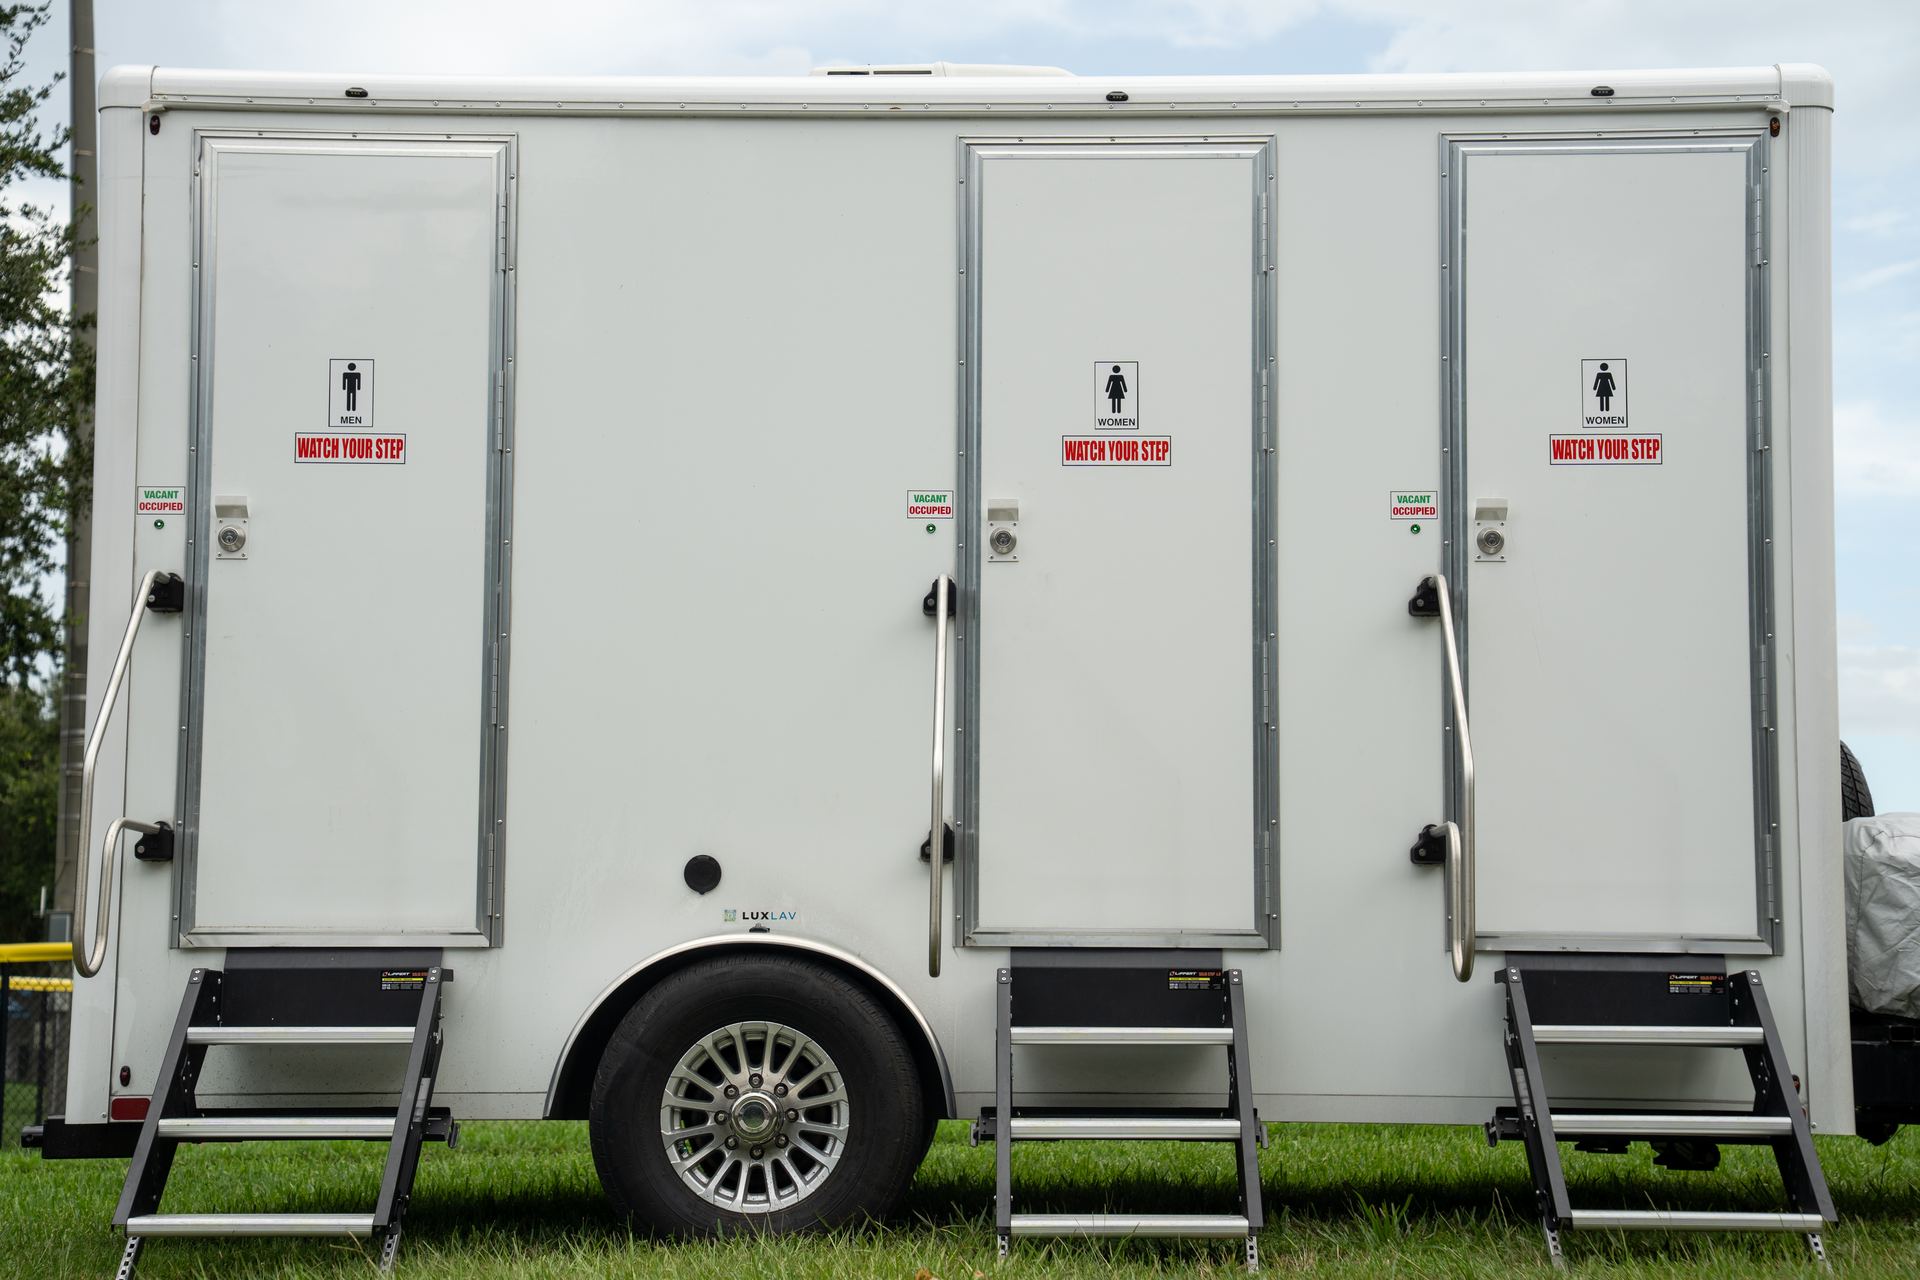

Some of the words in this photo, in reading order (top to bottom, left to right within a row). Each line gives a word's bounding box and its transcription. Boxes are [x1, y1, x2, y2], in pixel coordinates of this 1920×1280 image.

[340, 416, 362, 424] MEN
[1097, 418, 1136, 426] WOMEN
[1585, 416, 1625, 425] WOMEN
[297, 437, 339, 459] WATCH
[342, 438, 373, 459] YOUR
[375, 438, 404, 459] STEP
[1064, 440, 1106, 461] WATCH
[1108, 440, 1139, 461] YOUR
[1141, 440, 1169, 461] STEP
[1551, 439, 1595, 460] WATCH
[1597, 439, 1629, 460] YOUR
[1631, 438, 1660, 460] STEP
[144, 490, 179, 499] VACANT
[913, 494, 947, 503] VACANT
[1397, 495, 1431, 504] VACANT
[139, 502, 183, 511] OCCUPIED
[909, 506, 952, 515] OCCUPIED
[1392, 507, 1436, 516] OCCUPIED
[742, 911, 797, 920] LUXLAV
